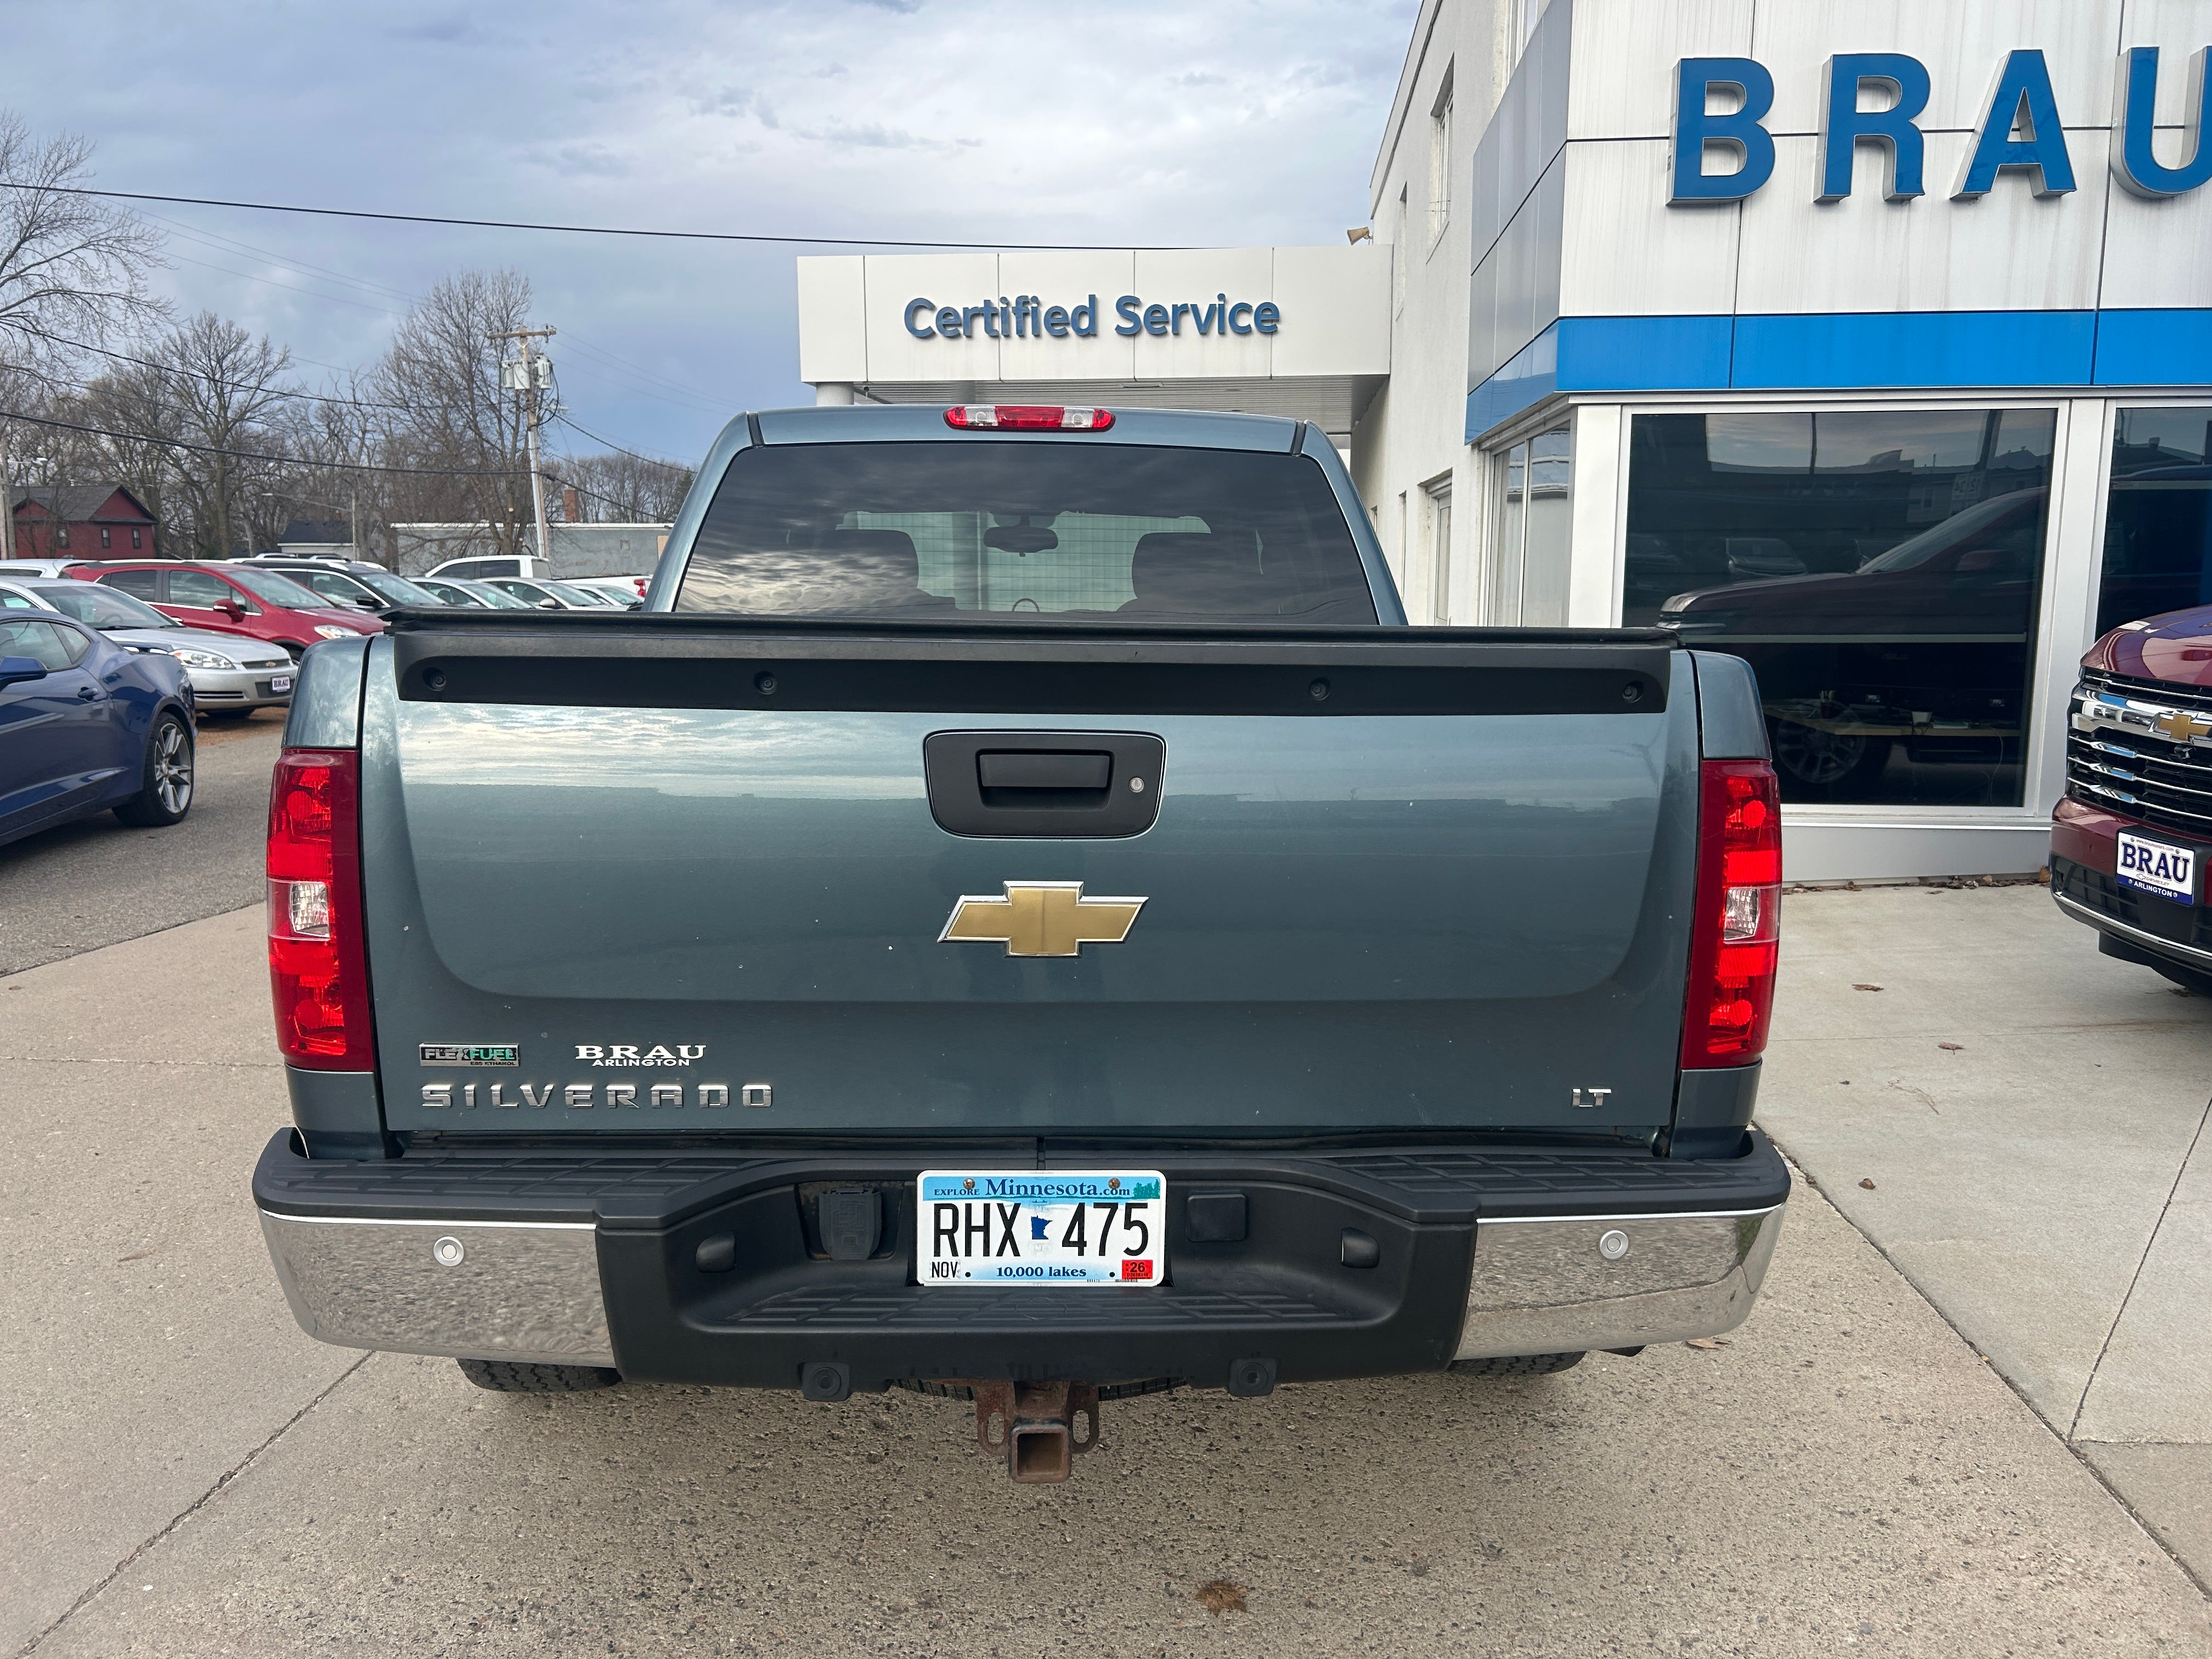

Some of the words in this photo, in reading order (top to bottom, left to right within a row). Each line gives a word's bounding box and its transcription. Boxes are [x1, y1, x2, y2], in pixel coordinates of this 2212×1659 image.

[1666, 45, 2212, 205] BRAU
[904, 294, 1097, 338] Certified
[1114, 293, 1280, 335] Service
[2120, 840, 2190, 884] BRAU
[2134, 881, 2172, 898] ARLINGTON
[575, 1045, 707, 1059] BRAU
[421, 1084, 772, 1109] SILVERADO
[1572, 1088, 1612, 1107] LT
[933, 1203, 1021, 1257] RHX
[1062, 1202, 1149, 1256] 475
[932, 1261, 958, 1278] NOV
[996, 1266, 1043, 1278] 10,000
[1048, 1266, 1087, 1277] lakes
[1130, 1262, 1146, 1273] 26
